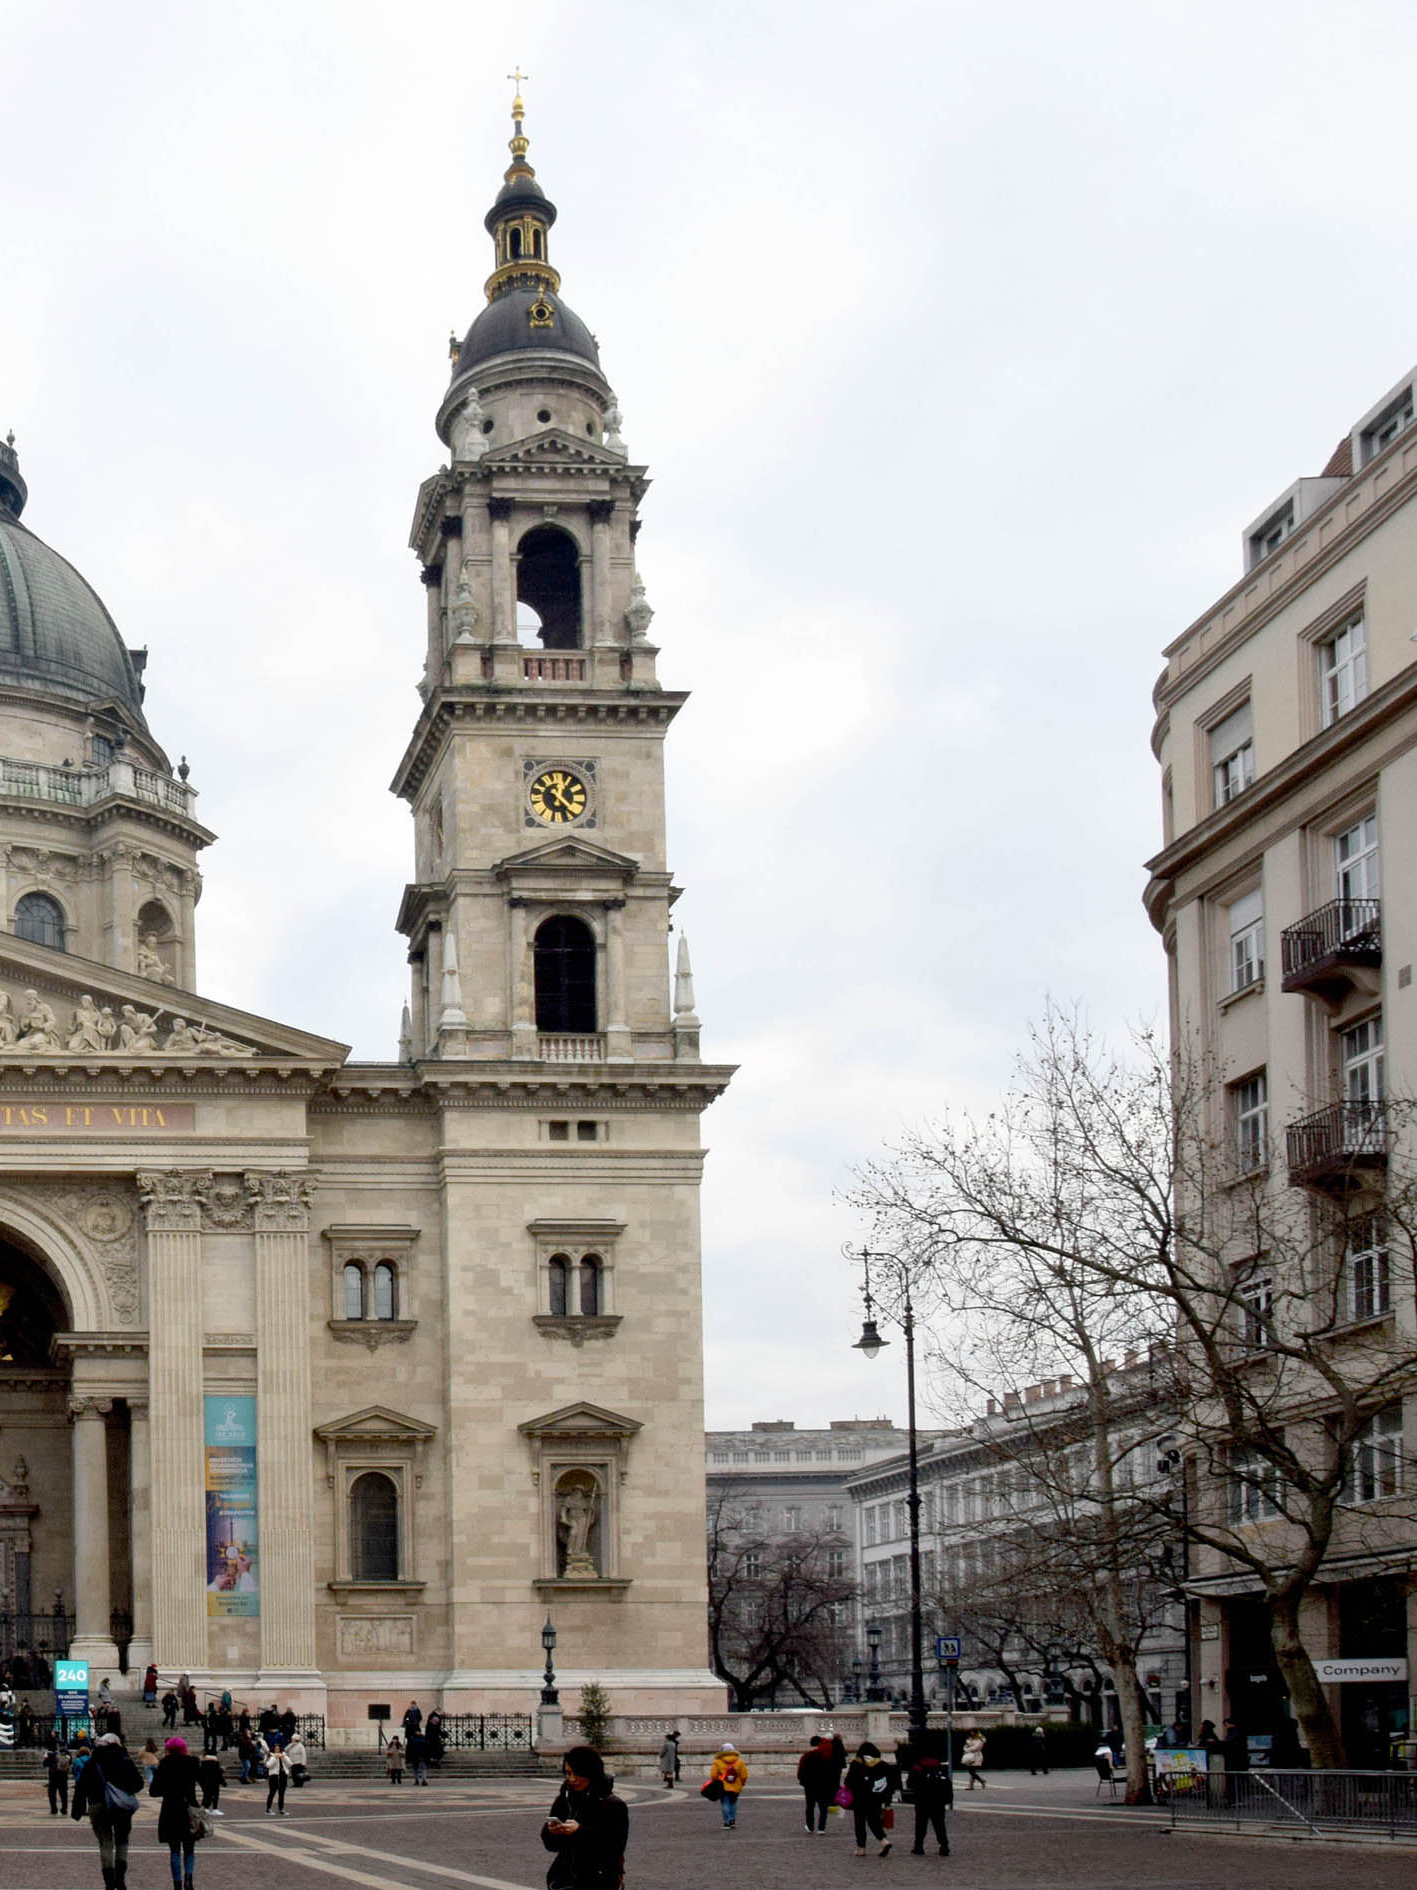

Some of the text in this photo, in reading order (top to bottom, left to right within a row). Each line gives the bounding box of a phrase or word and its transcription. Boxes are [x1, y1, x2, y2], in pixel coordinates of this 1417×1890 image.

[64, 1107, 95, 1127] ET
[111, 1107, 167, 1128] VITA
[57, 1669, 87, 1681] 240
[1322, 1665, 1401, 1676] Company
